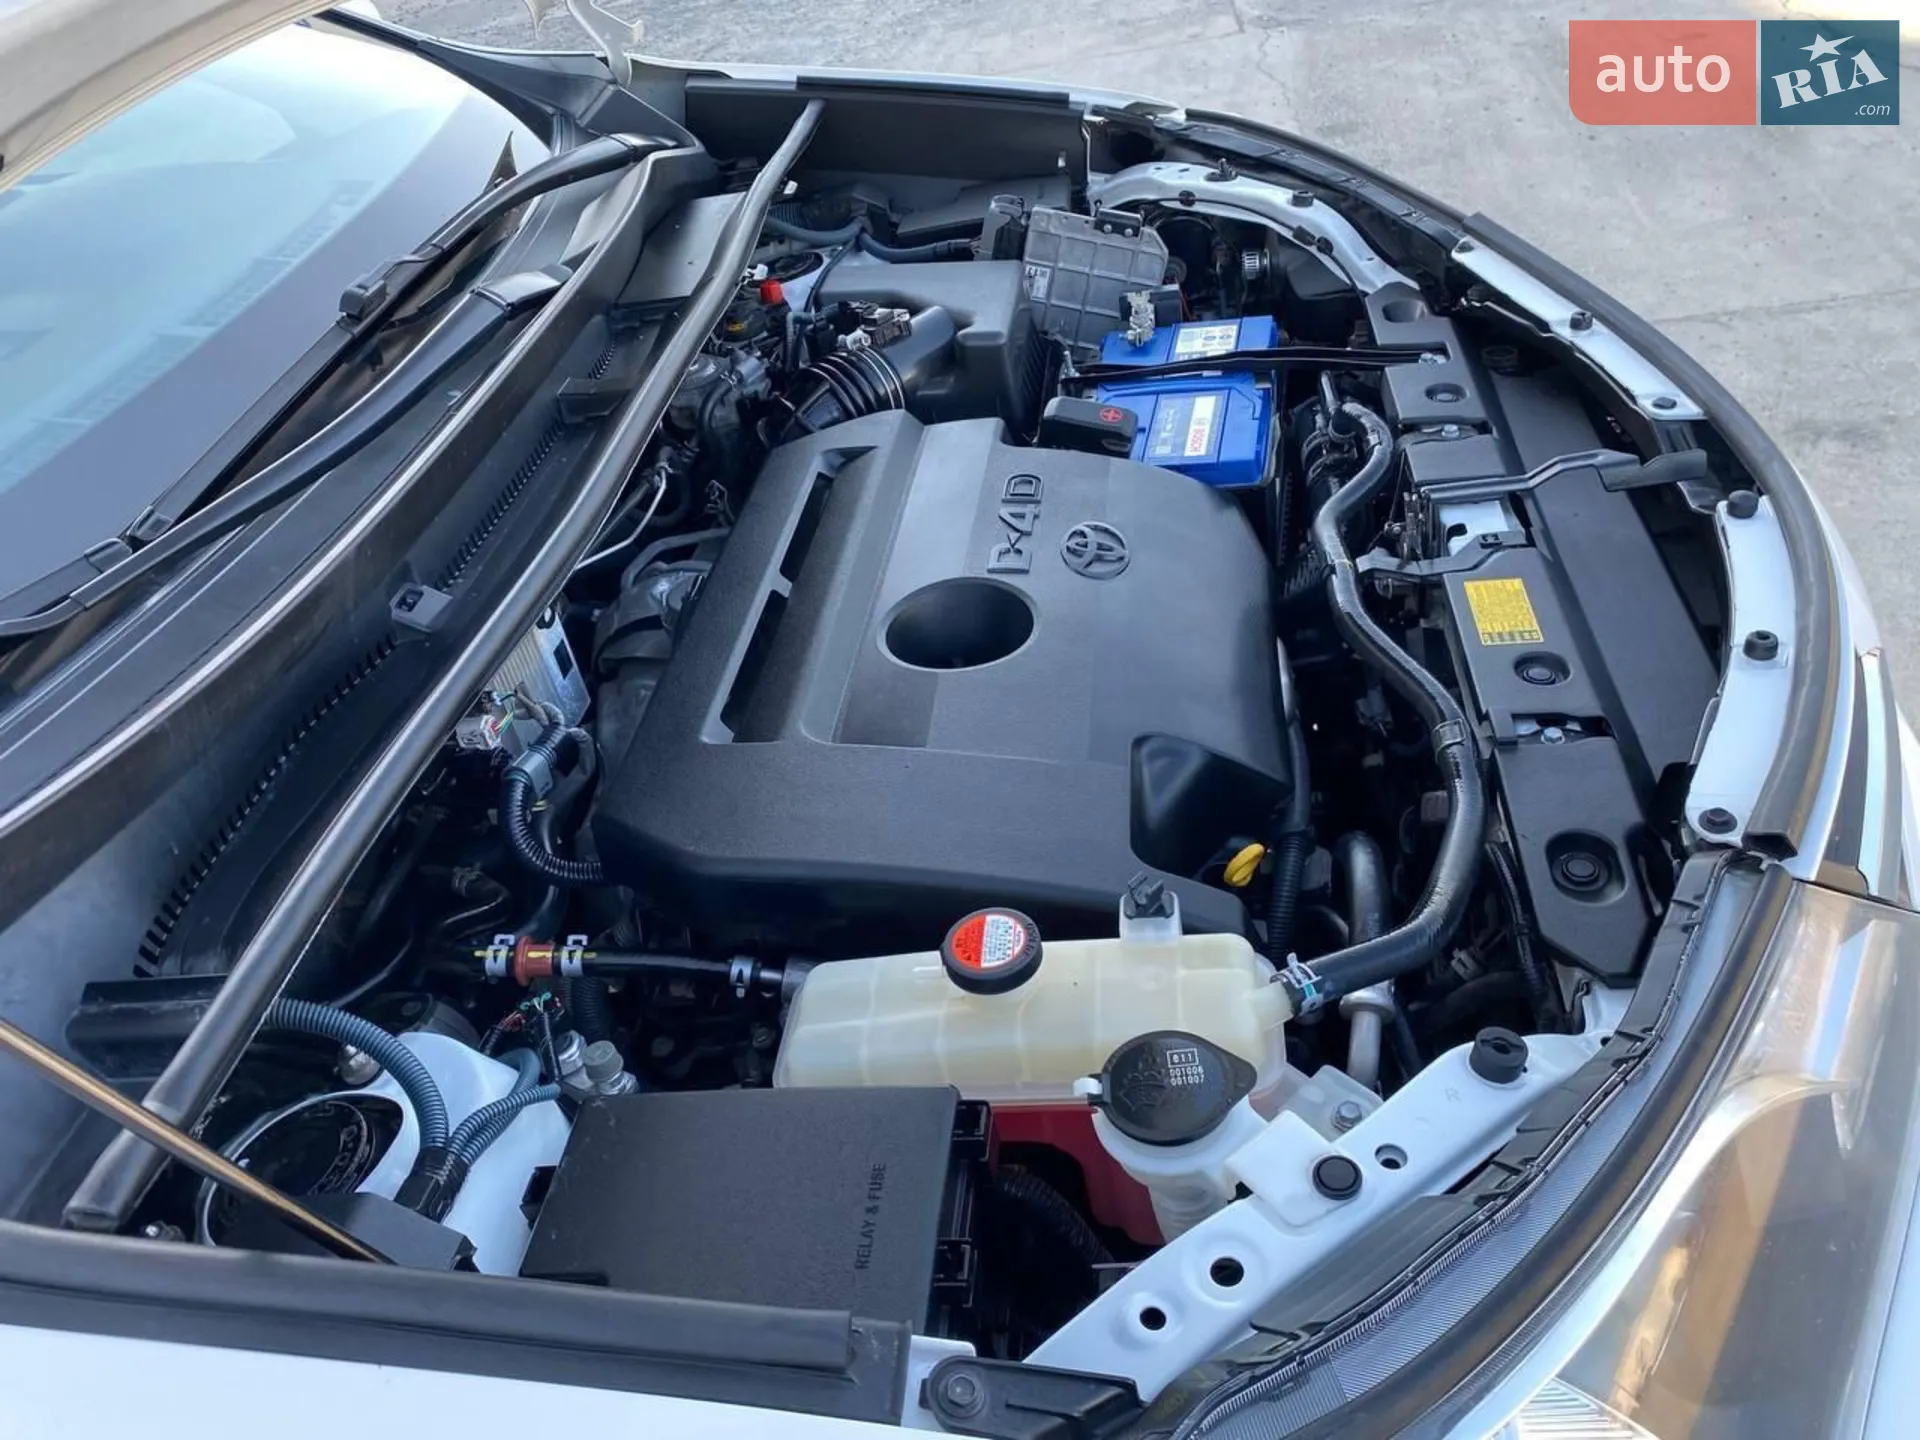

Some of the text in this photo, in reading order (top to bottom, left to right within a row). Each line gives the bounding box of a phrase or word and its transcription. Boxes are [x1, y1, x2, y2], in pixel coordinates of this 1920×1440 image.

[855, 1163, 887, 1269] RELAY & FUSE
